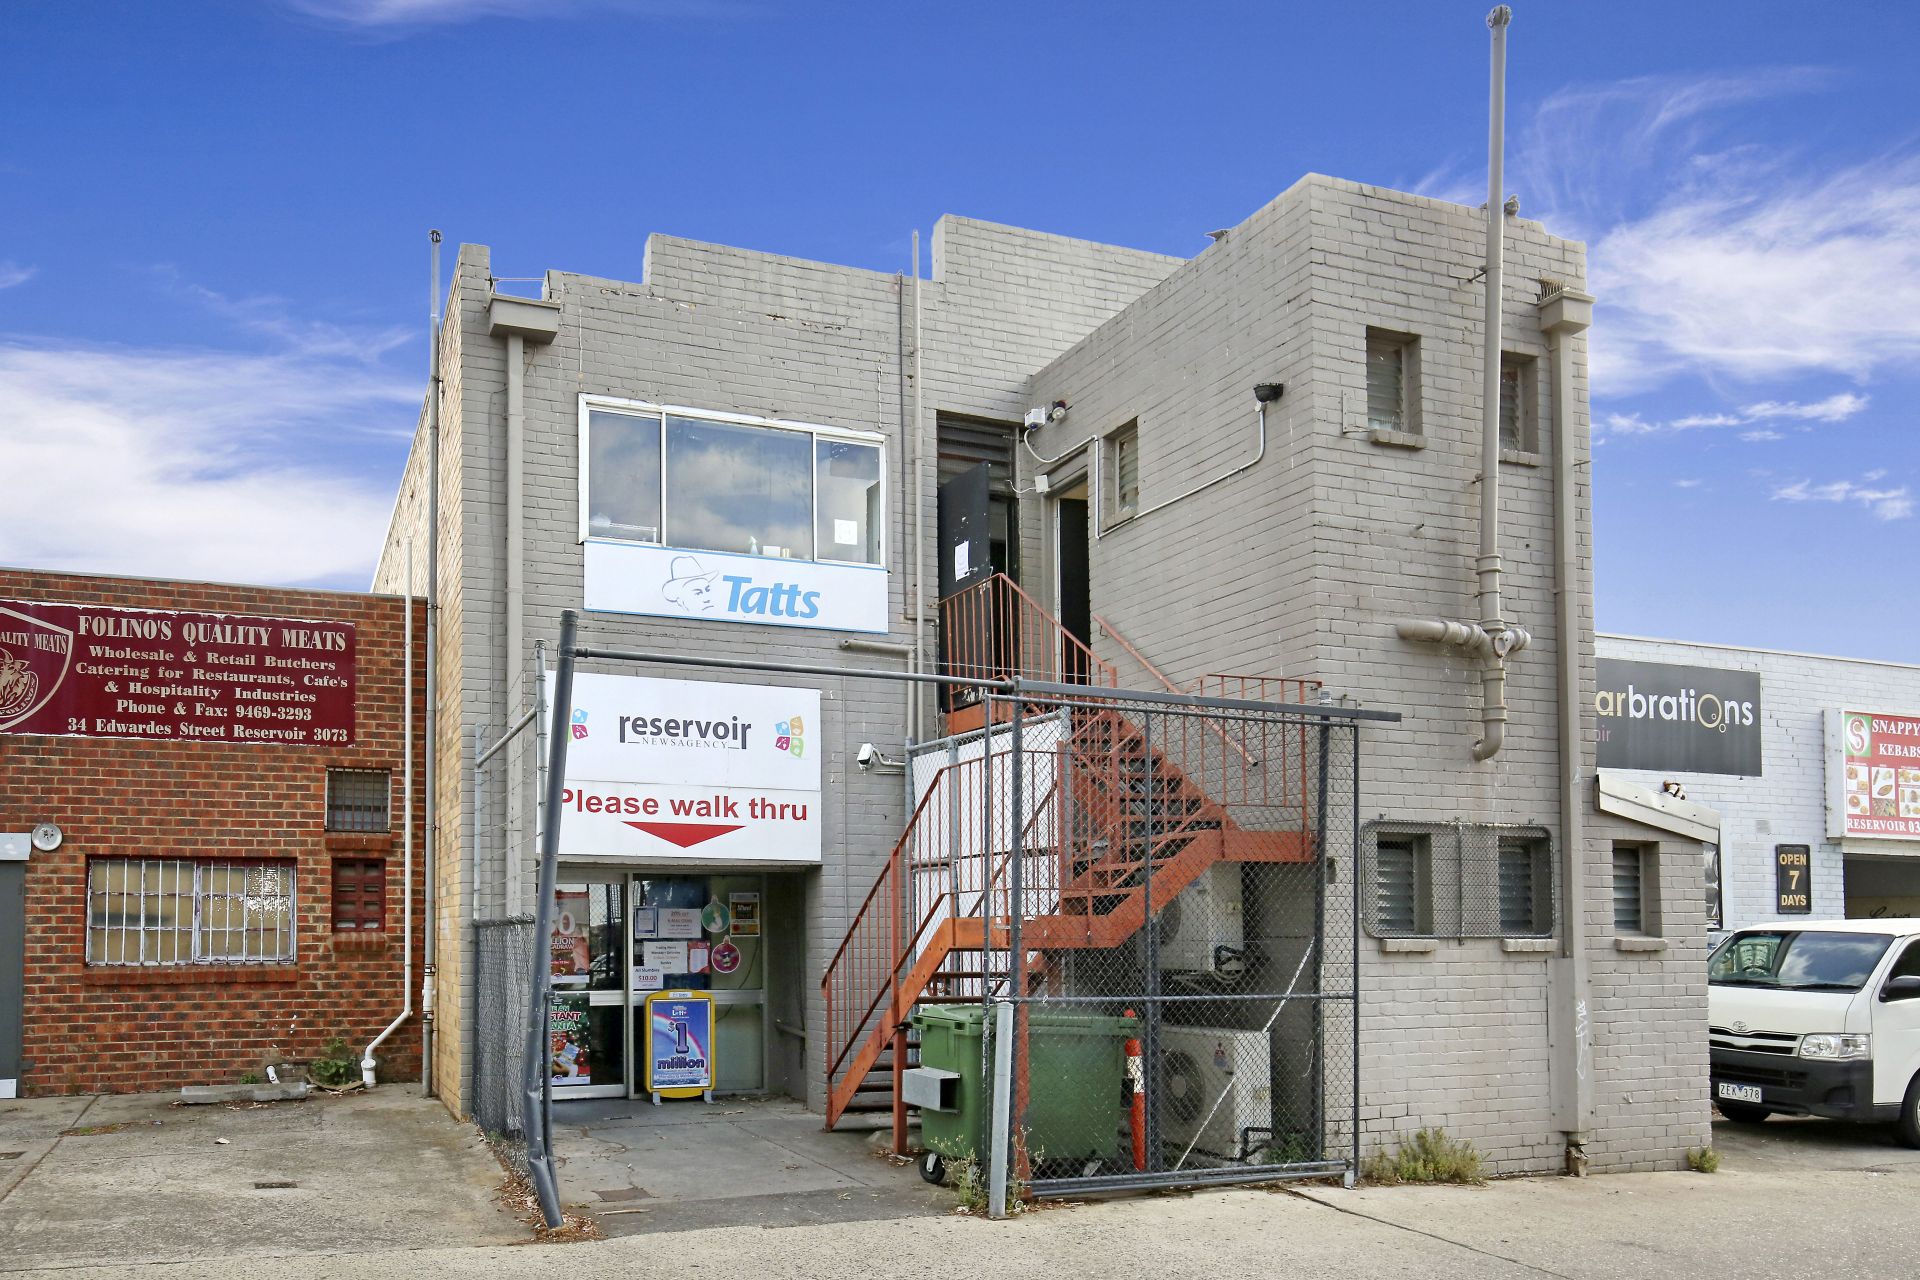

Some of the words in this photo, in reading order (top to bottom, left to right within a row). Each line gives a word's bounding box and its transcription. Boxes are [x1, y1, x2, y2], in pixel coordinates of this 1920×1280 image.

[723, 575, 821, 619] Tatts
[34, 633, 67, 654] MEATS
[78, 615, 173, 641] FOLINO'S
[182, 622, 272, 647] QUALITY
[281, 628, 347, 651] MEATS
[89, 645, 174, 662] Wholesale
[183, 650, 198, 663] &
[207, 652, 257, 667] Retail
[264, 655, 336, 671] Butchers
[75, 662, 150, 680] Catering
[158, 665, 184, 680] for
[192, 669, 296, 687] Restaurants,
[303, 673, 349, 688] Cafe's
[104, 681, 119, 693] &
[128, 682, 221, 700] Hospitality
[234, 687, 317, 703] Industries
[116, 699, 166, 715] Phone
[173, 702, 188, 716] &
[194, 703, 229, 718] Fax:
[235, 705, 313, 721] 9469-3293
[68, 718, 88, 732] 34
[96, 718, 172, 736] Edwardes
[179, 722, 226, 738] Street
[233, 724, 307, 741] Reservoir
[313, 728, 349, 742] 3073
[619, 715, 752, 750] reservoir
[1872, 719, 1920, 736] SNAPPY
[642, 736, 729, 749] NEWSAGENCY
[561, 789, 659, 815] Please
[669, 795, 739, 819] walk
[749, 797, 807, 821] thru
[1847, 818, 1907, 832] RESERVOIR
[1779, 853, 1807, 866] OPEN
[1789, 870, 1800, 890] 7
[1781, 893, 1807, 906] DAYS
[657, 1056, 705, 1070] million
[1743, 1088, 1760, 1099] 378
